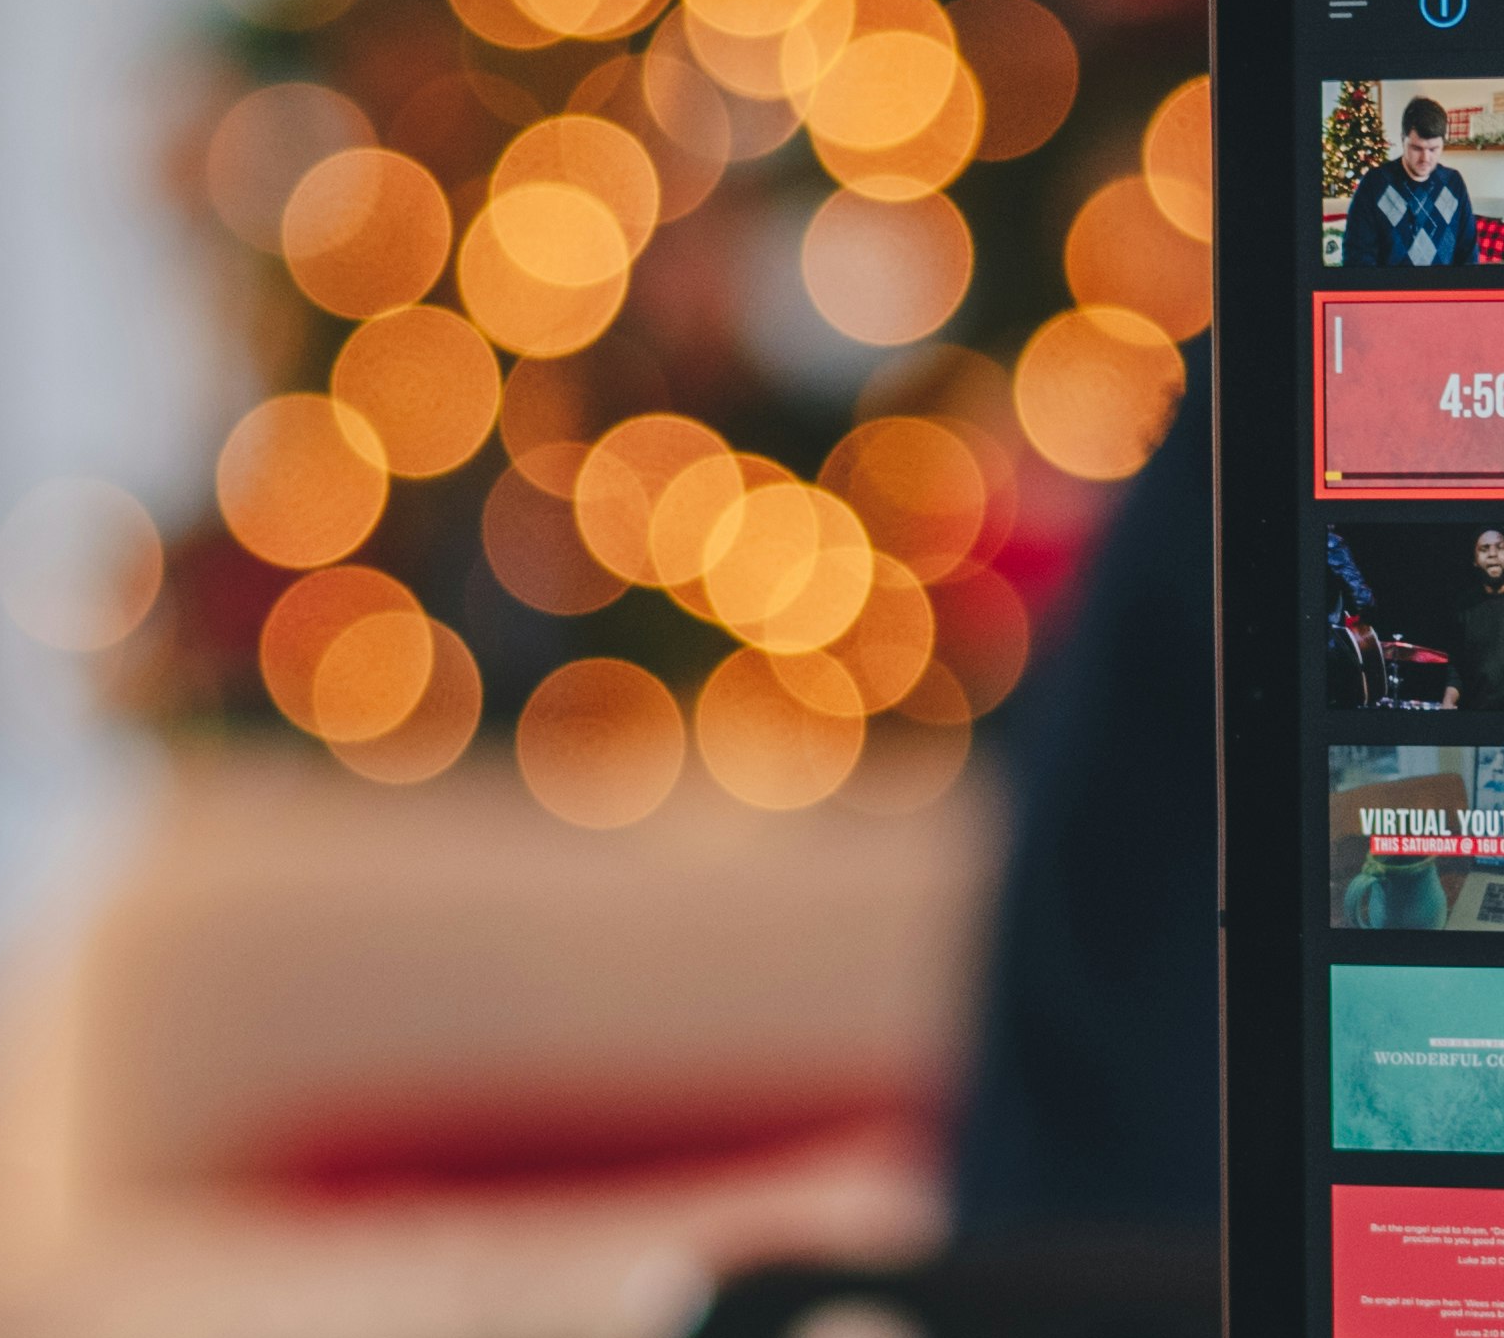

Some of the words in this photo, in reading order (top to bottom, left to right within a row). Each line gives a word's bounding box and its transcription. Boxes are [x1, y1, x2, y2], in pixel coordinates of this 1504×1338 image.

[1360, 808, 1452, 836] VIRTUAL
[1374, 836, 1399, 851] THIS
[1401, 837, 1458, 852] SATURDAY
[1460, 838, 1473, 852] @
[1477, 838, 1497, 853] 16U
[1374, 1051, 1482, 1068] WONDERFUL
